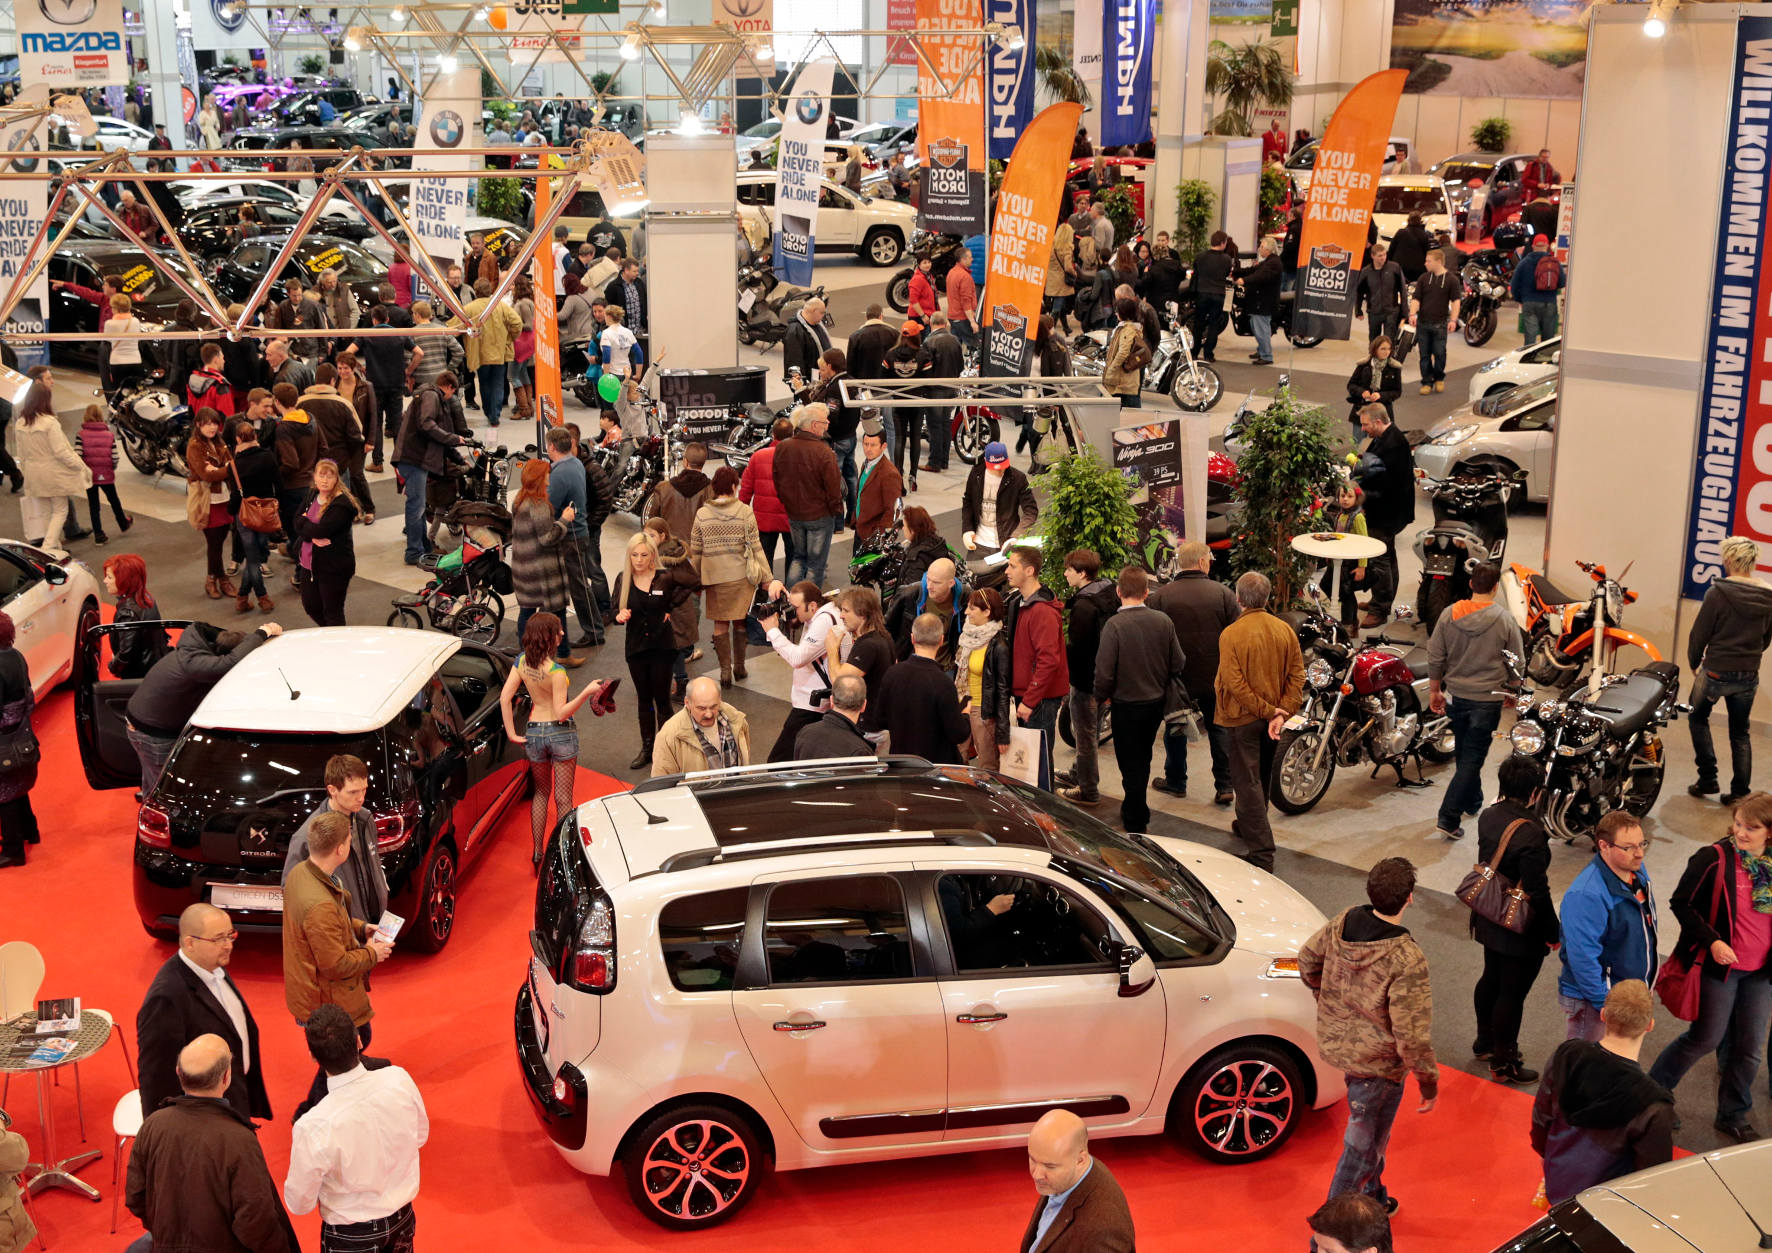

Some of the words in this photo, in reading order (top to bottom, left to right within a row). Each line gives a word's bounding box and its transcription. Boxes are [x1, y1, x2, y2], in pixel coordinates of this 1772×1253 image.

[785, 140, 808, 156] YOU
[783, 156, 819, 174] NEVER
[1319, 150, 1355, 168] YOU
[1723, 38, 1772, 278] WILLKOMMEN
[782, 171, 806, 186] RIDE
[1314, 168, 1371, 190] NEVER
[416, 186, 464, 206] NEVER
[781, 185, 817, 203] ALONE
[1311, 186, 1349, 205] RIDE
[0, 199, 28, 217] YOU
[416, 204, 446, 221] RIDE
[1000, 191, 1034, 217] YOU
[1308, 204, 1368, 225] ALONE!
[417, 220, 461, 240] ALONE
[782, 231, 808, 244] MOTO
[996, 214, 1048, 245] NEVER
[0, 239, 28, 257] RIDE
[782, 241, 807, 254] DROM
[993, 233, 1027, 258] RIDE
[991, 254, 1045, 286] ALONE!
[1310, 267, 1346, 280] MOTO
[1309, 277, 1345, 290] DROM
[1719, 285, 1752, 329] IM
[5, 322, 43, 333] MOTO
[992, 330, 1023, 349] MOTO
[991, 341, 1020, 360] DROM
[1117, 444, 1144, 463] Ninja
[1692, 335, 1748, 585] FAHRZEUGHAUS
